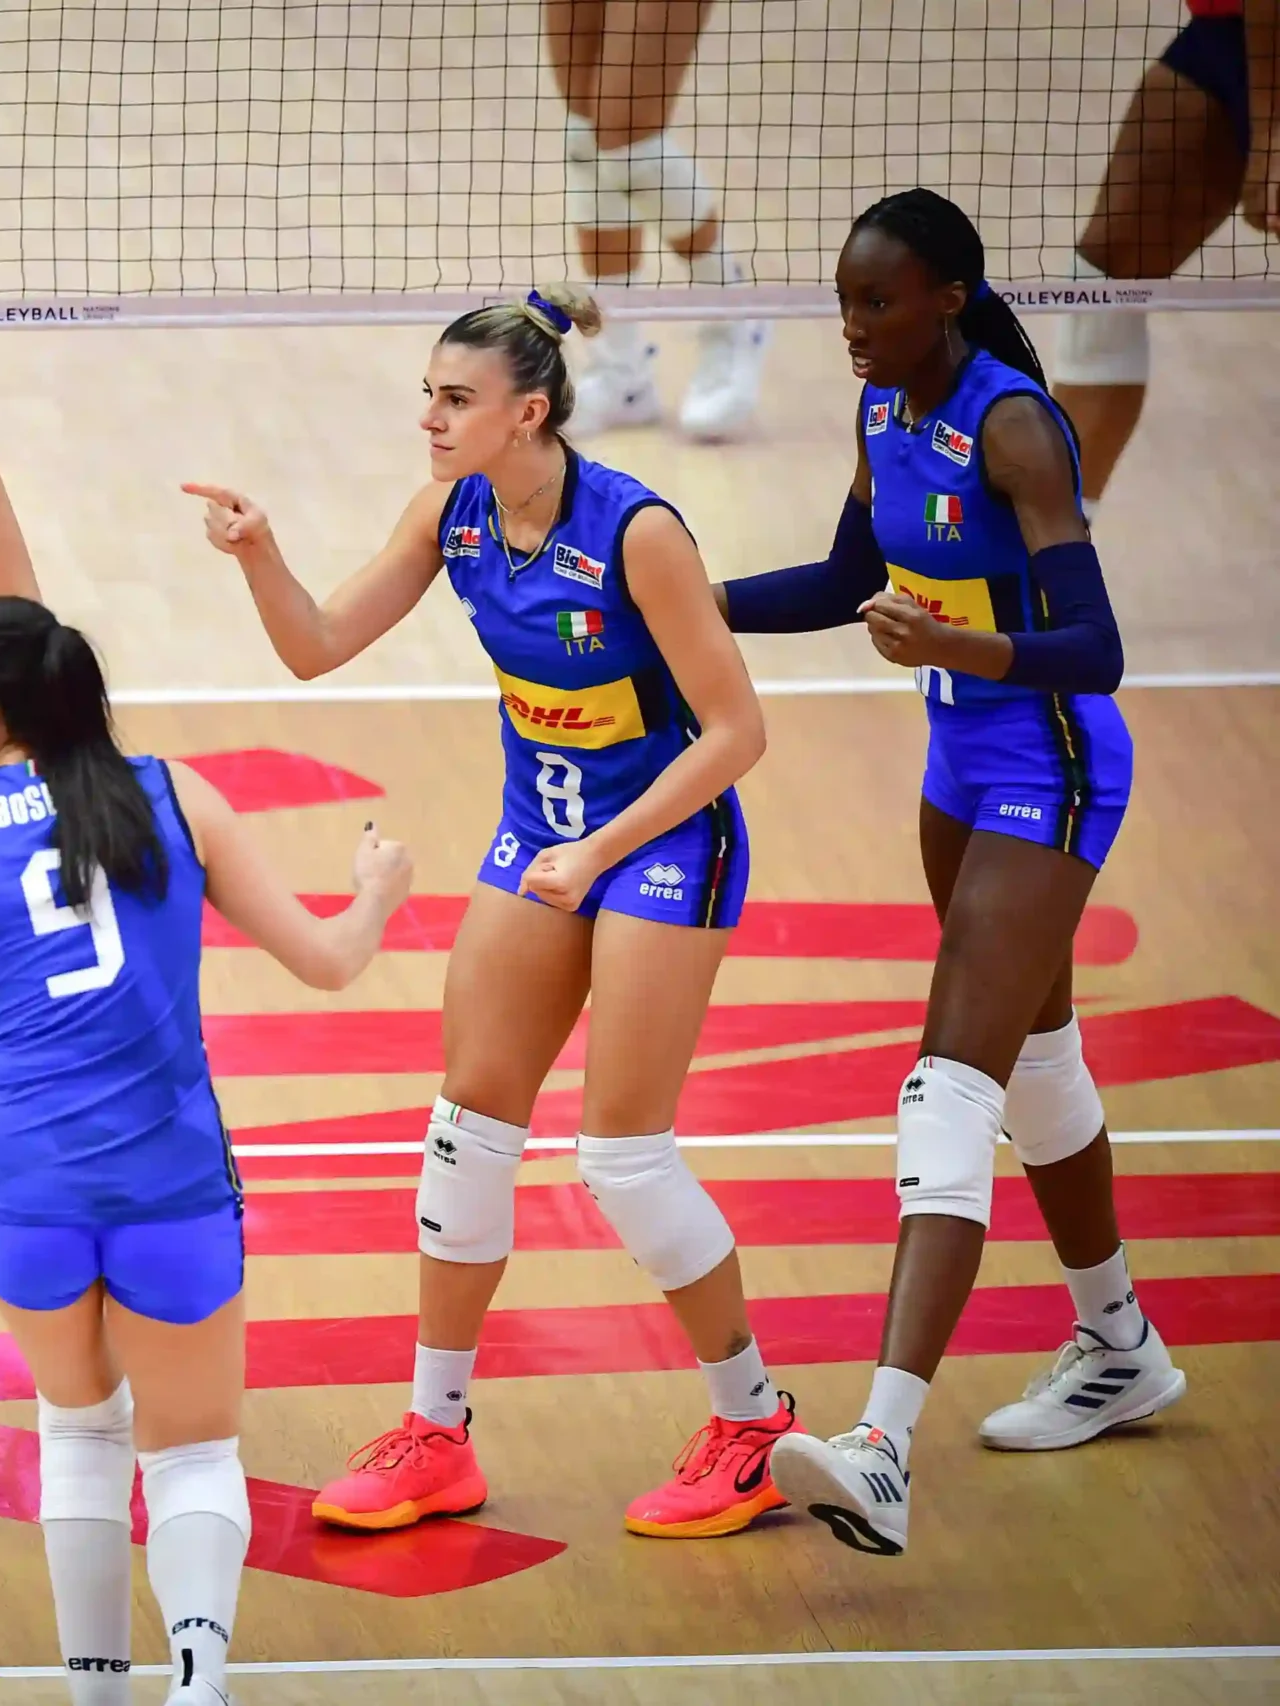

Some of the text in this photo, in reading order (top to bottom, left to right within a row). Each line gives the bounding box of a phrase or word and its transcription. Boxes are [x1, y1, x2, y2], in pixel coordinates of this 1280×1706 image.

[998, 290, 1111, 305] OLLEYBALL
[927, 524, 962, 541] ITA
[565, 635, 605, 657] ITA
[508, 692, 594, 731] DHL
[535, 751, 587, 839] 8
[999, 803, 1042, 820] errea
[494, 831, 521, 868] 8
[640, 883, 683, 901] errea
[20, 848, 125, 999] 9
